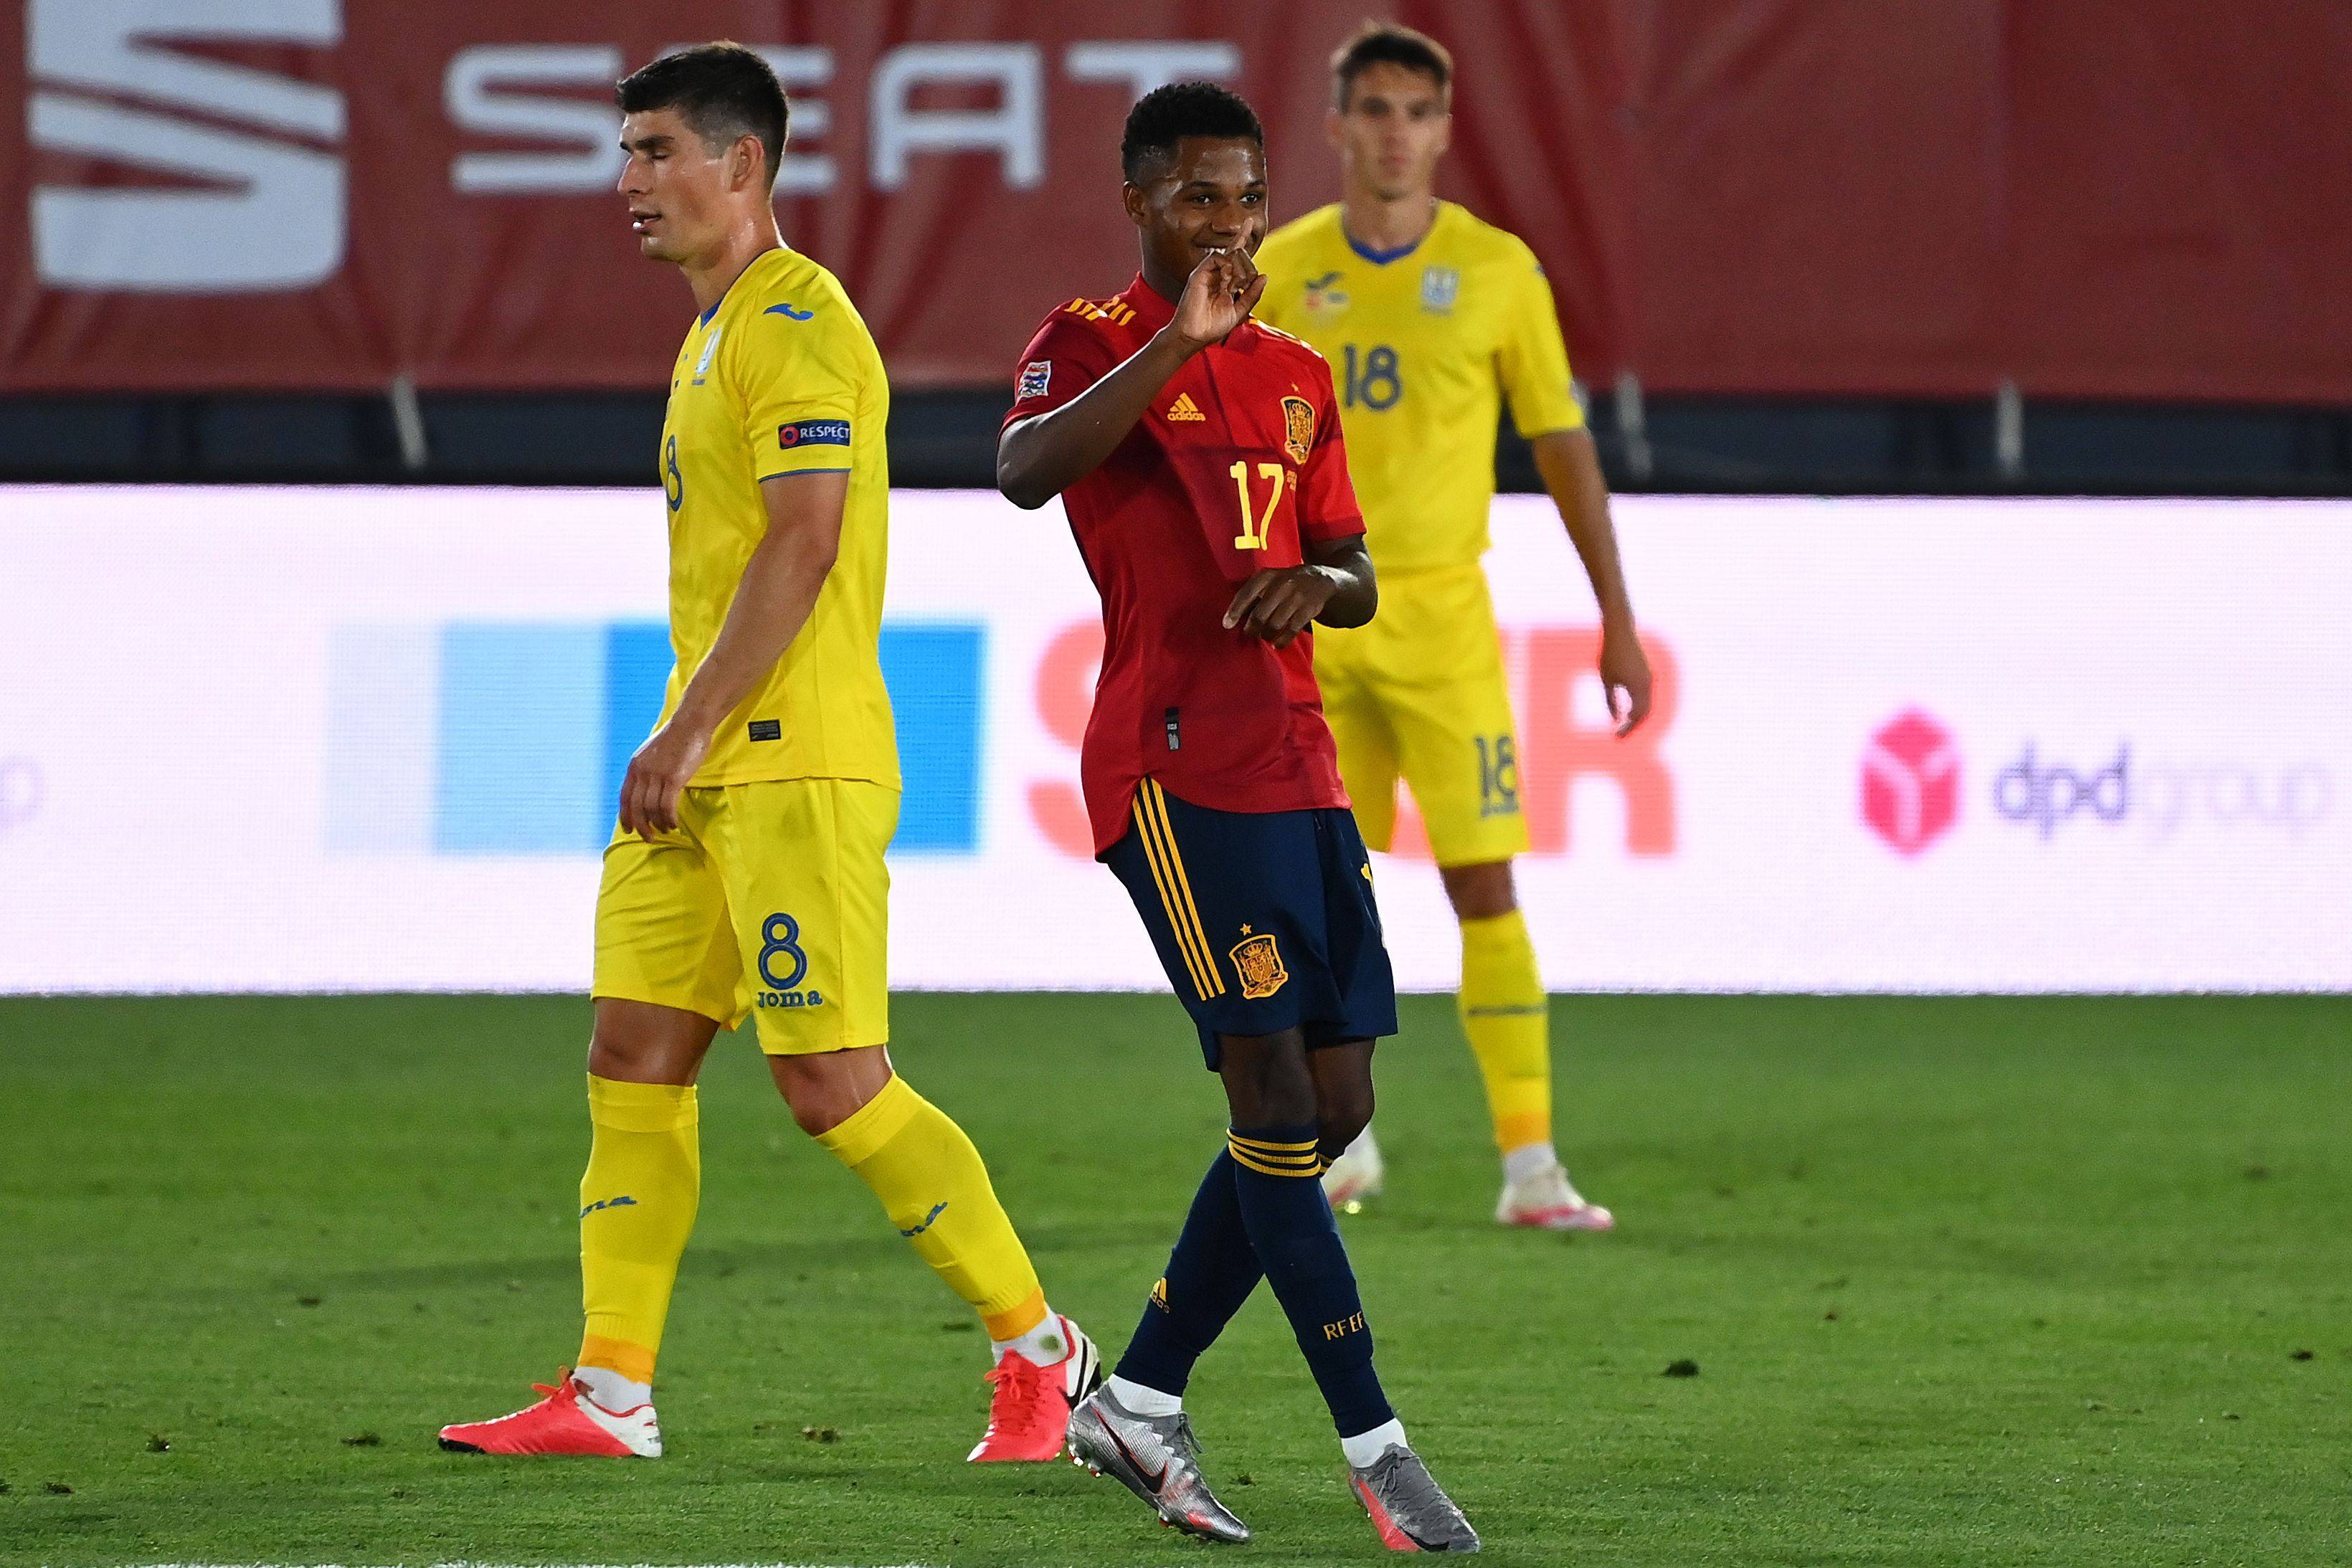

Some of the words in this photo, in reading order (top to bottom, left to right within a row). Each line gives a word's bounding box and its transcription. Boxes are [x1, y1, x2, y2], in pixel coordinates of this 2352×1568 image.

[1344, 344, 1403, 412] 18
[800, 425, 850, 439] RESPECT
[665, 434, 682, 513] 8
[1229, 460, 1285, 551] 17
[1474, 734, 1517, 798] 18
[757, 912, 807, 991] 8
